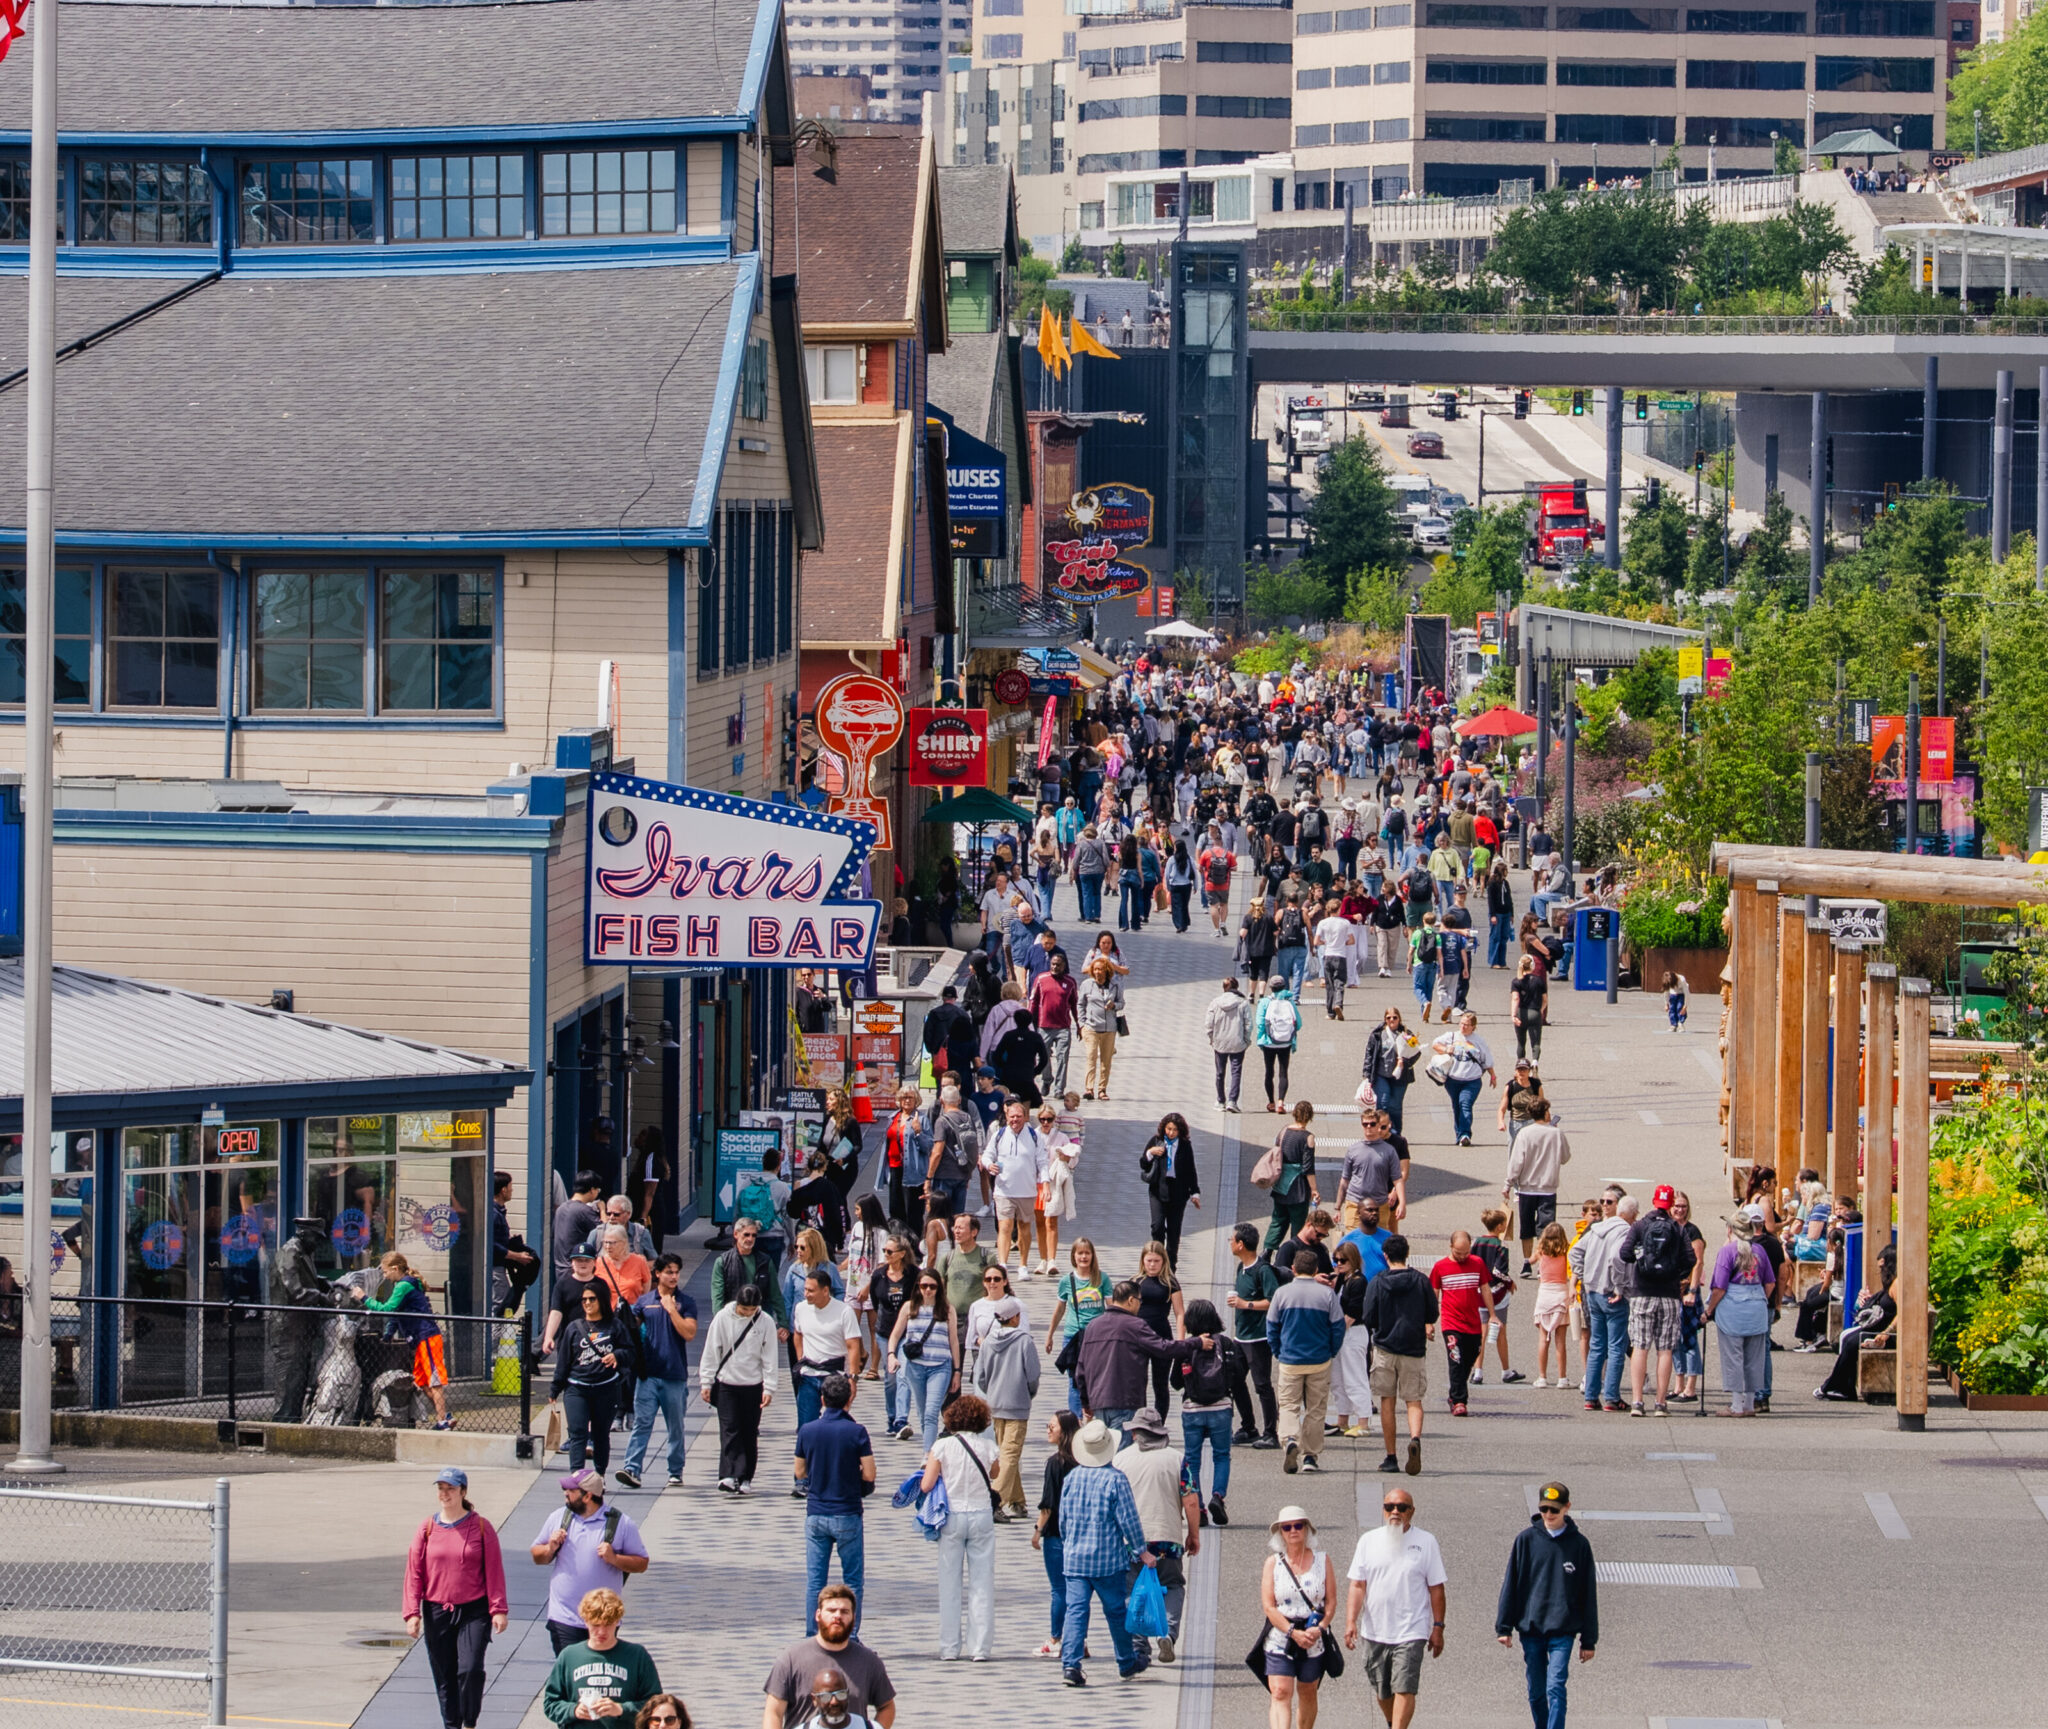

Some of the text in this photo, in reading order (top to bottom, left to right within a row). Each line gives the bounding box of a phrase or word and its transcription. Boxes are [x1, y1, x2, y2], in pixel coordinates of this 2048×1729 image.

[1288, 395, 1323, 407] FedEx
[946, 469, 1000, 487] RUISES
[1083, 535, 1099, 545] the
[1046, 538, 1118, 563] Crab
[1059, 559, 1109, 587] Pot
[1051, 586, 1097, 602] RESTAURANT
[1104, 587, 1119, 599] BAR
[933, 719, 965, 728] SEATTLE
[917, 735, 982, 752] SHIRT
[1832, 917, 1884, 928] LEMONADE
[595, 914, 867, 959] FISH BAR
[456, 1119, 481, 1134] Cones
[220, 1131, 257, 1152] OPEN
[721, 1132, 762, 1143] Soccer
[573, 1662, 604, 1682] CATALINA
[604, 1663, 628, 1681] ISLAND
[609, 1687, 622, 1697] BAY
